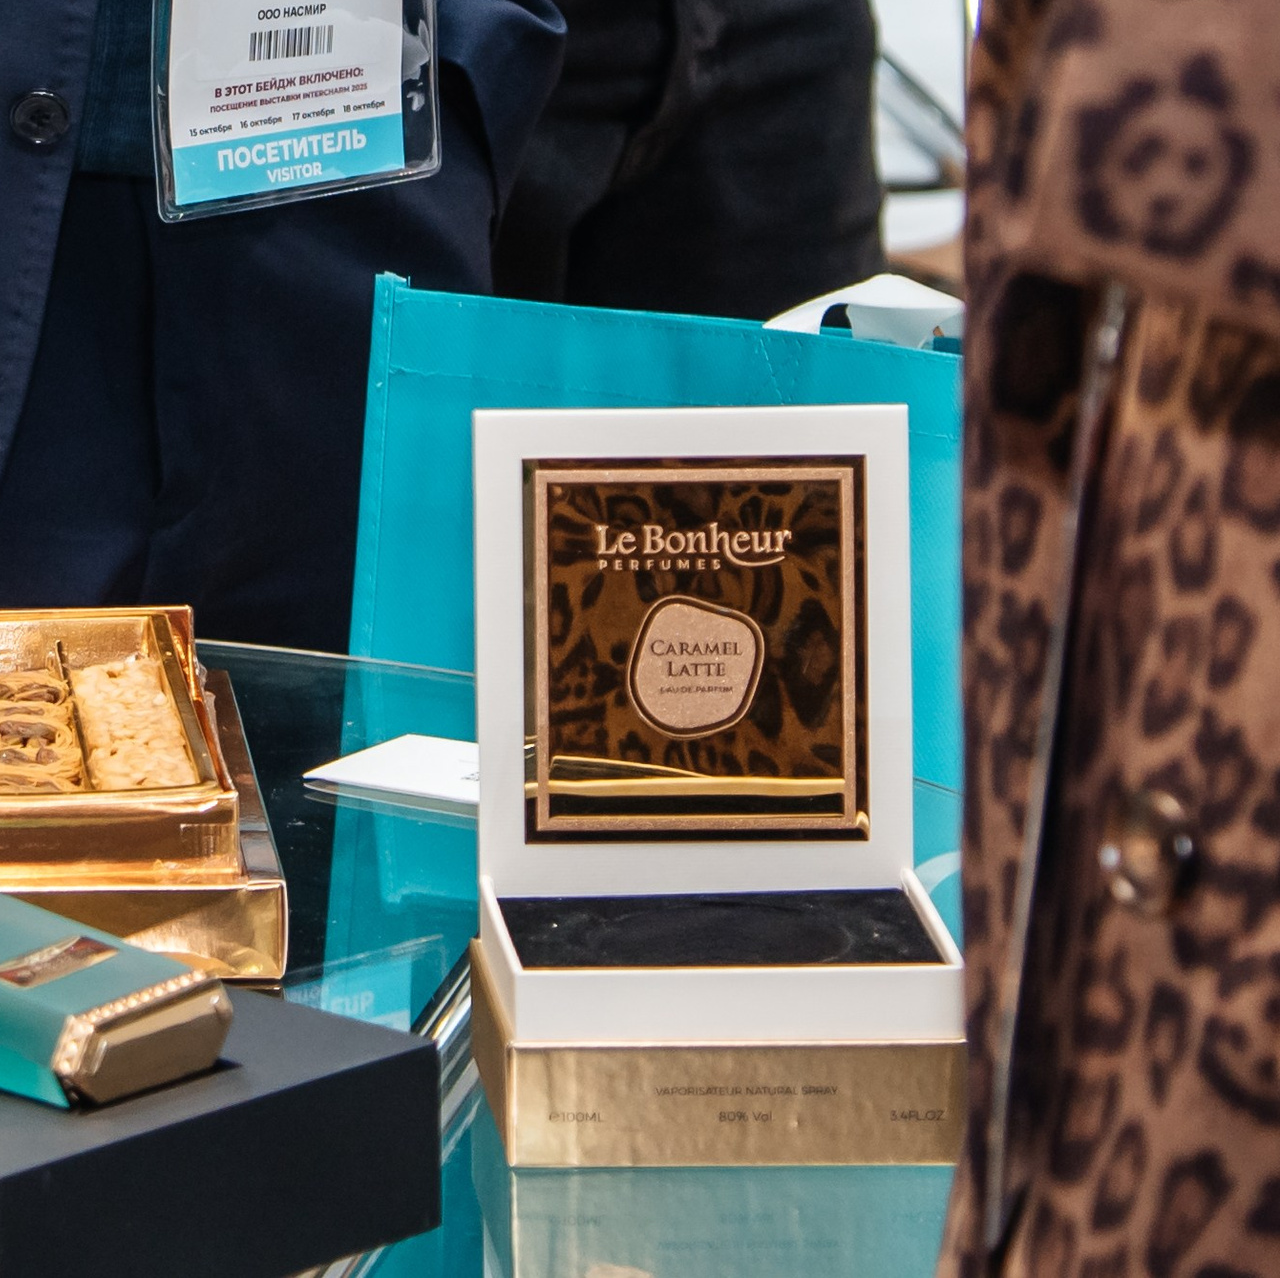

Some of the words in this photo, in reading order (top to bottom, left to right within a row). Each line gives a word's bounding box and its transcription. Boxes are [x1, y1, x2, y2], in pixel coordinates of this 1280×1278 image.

[257, 7, 281, 21] ООО
[283, 3, 327, 18] НАСМИР
[214, 88, 222, 98] В
[225, 83, 253, 97] ЭТОТ
[256, 76, 297, 92] БЕЙДЖ
[299, 67, 364, 86] ВКЛЮЧЕНО:
[210, 99, 258, 113] ПОСЕЩЕНИЕ
[260, 93, 301, 106] ВЫСТАВКИ
[303, 86, 350, 100] INTERCHARM
[343, 104, 351, 113] 18
[353, 100, 385, 111] октября
[240, 120, 249, 129] 16
[250, 116, 282, 127] октября
[292, 112, 300, 121] 17
[302, 108, 335, 119] октября
[189, 128, 198, 137] 15
[200, 123, 232, 135] октября
[216, 128, 368, 171] ПОСЕТИТЕЛЬ
[267, 161, 323, 184] VISITOR
[597, 523, 636, 556] Le
[642, 522, 793, 567] Bonheur
[598, 558, 722, 571] PERFUMES
[650, 639, 743, 657] CARAMEL
[667, 661, 727, 678] LATTE
[655, 1086, 743, 1096] VAPORISATEUR
[745, 1086, 799, 1096] NATURAL
[801, 1085, 838, 1096] SPRAY
[718, 1111, 749, 1123] 80%
